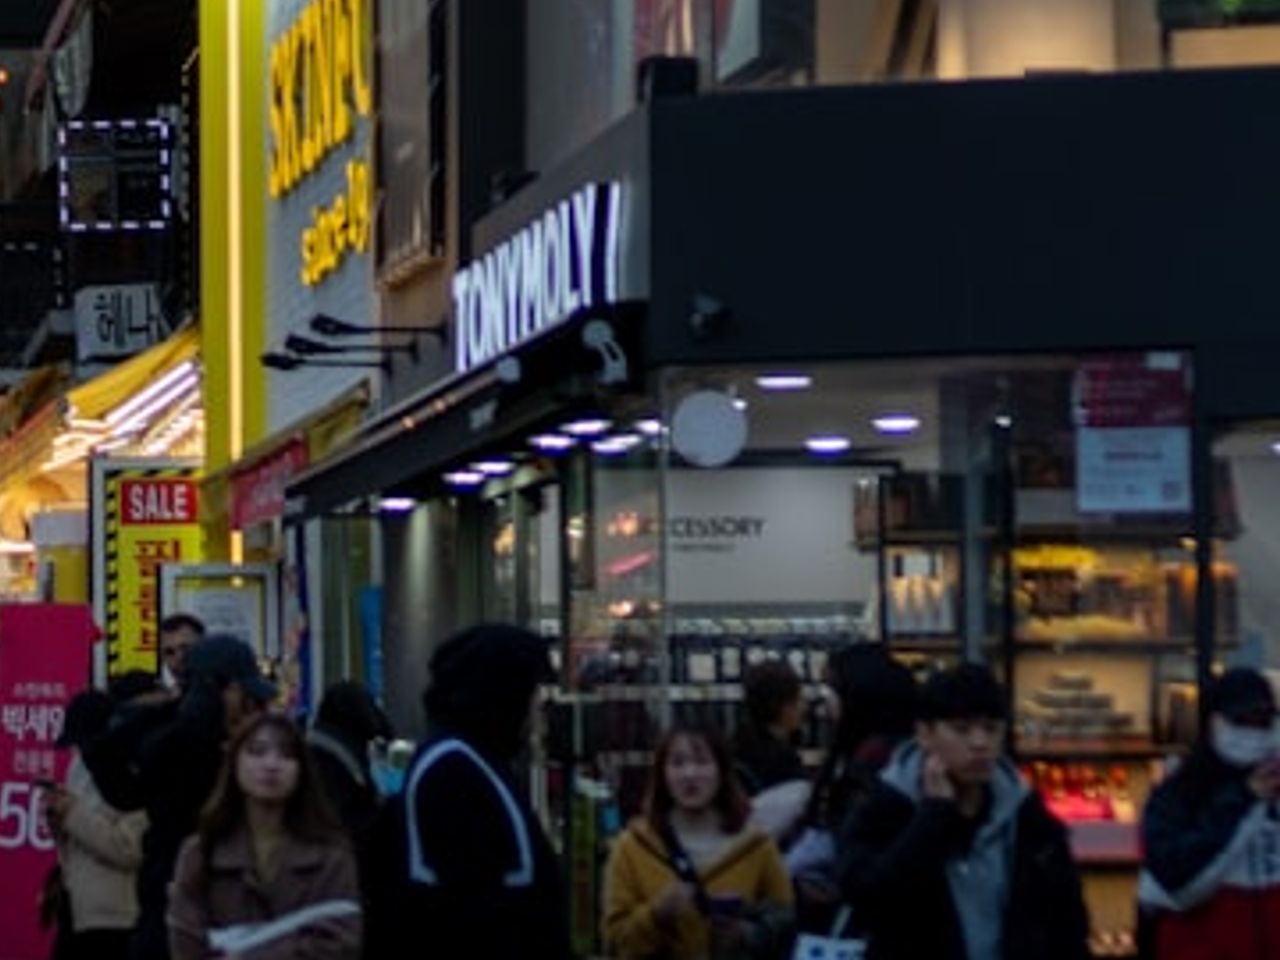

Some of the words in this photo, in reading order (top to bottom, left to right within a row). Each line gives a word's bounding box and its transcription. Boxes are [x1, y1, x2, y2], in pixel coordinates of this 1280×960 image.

[452, 182, 597, 372] TONYMOLY
[93, 287, 159, 349] 헤나
[128, 483, 190, 520] SALE
[643, 515, 765, 537] CCESSORY
